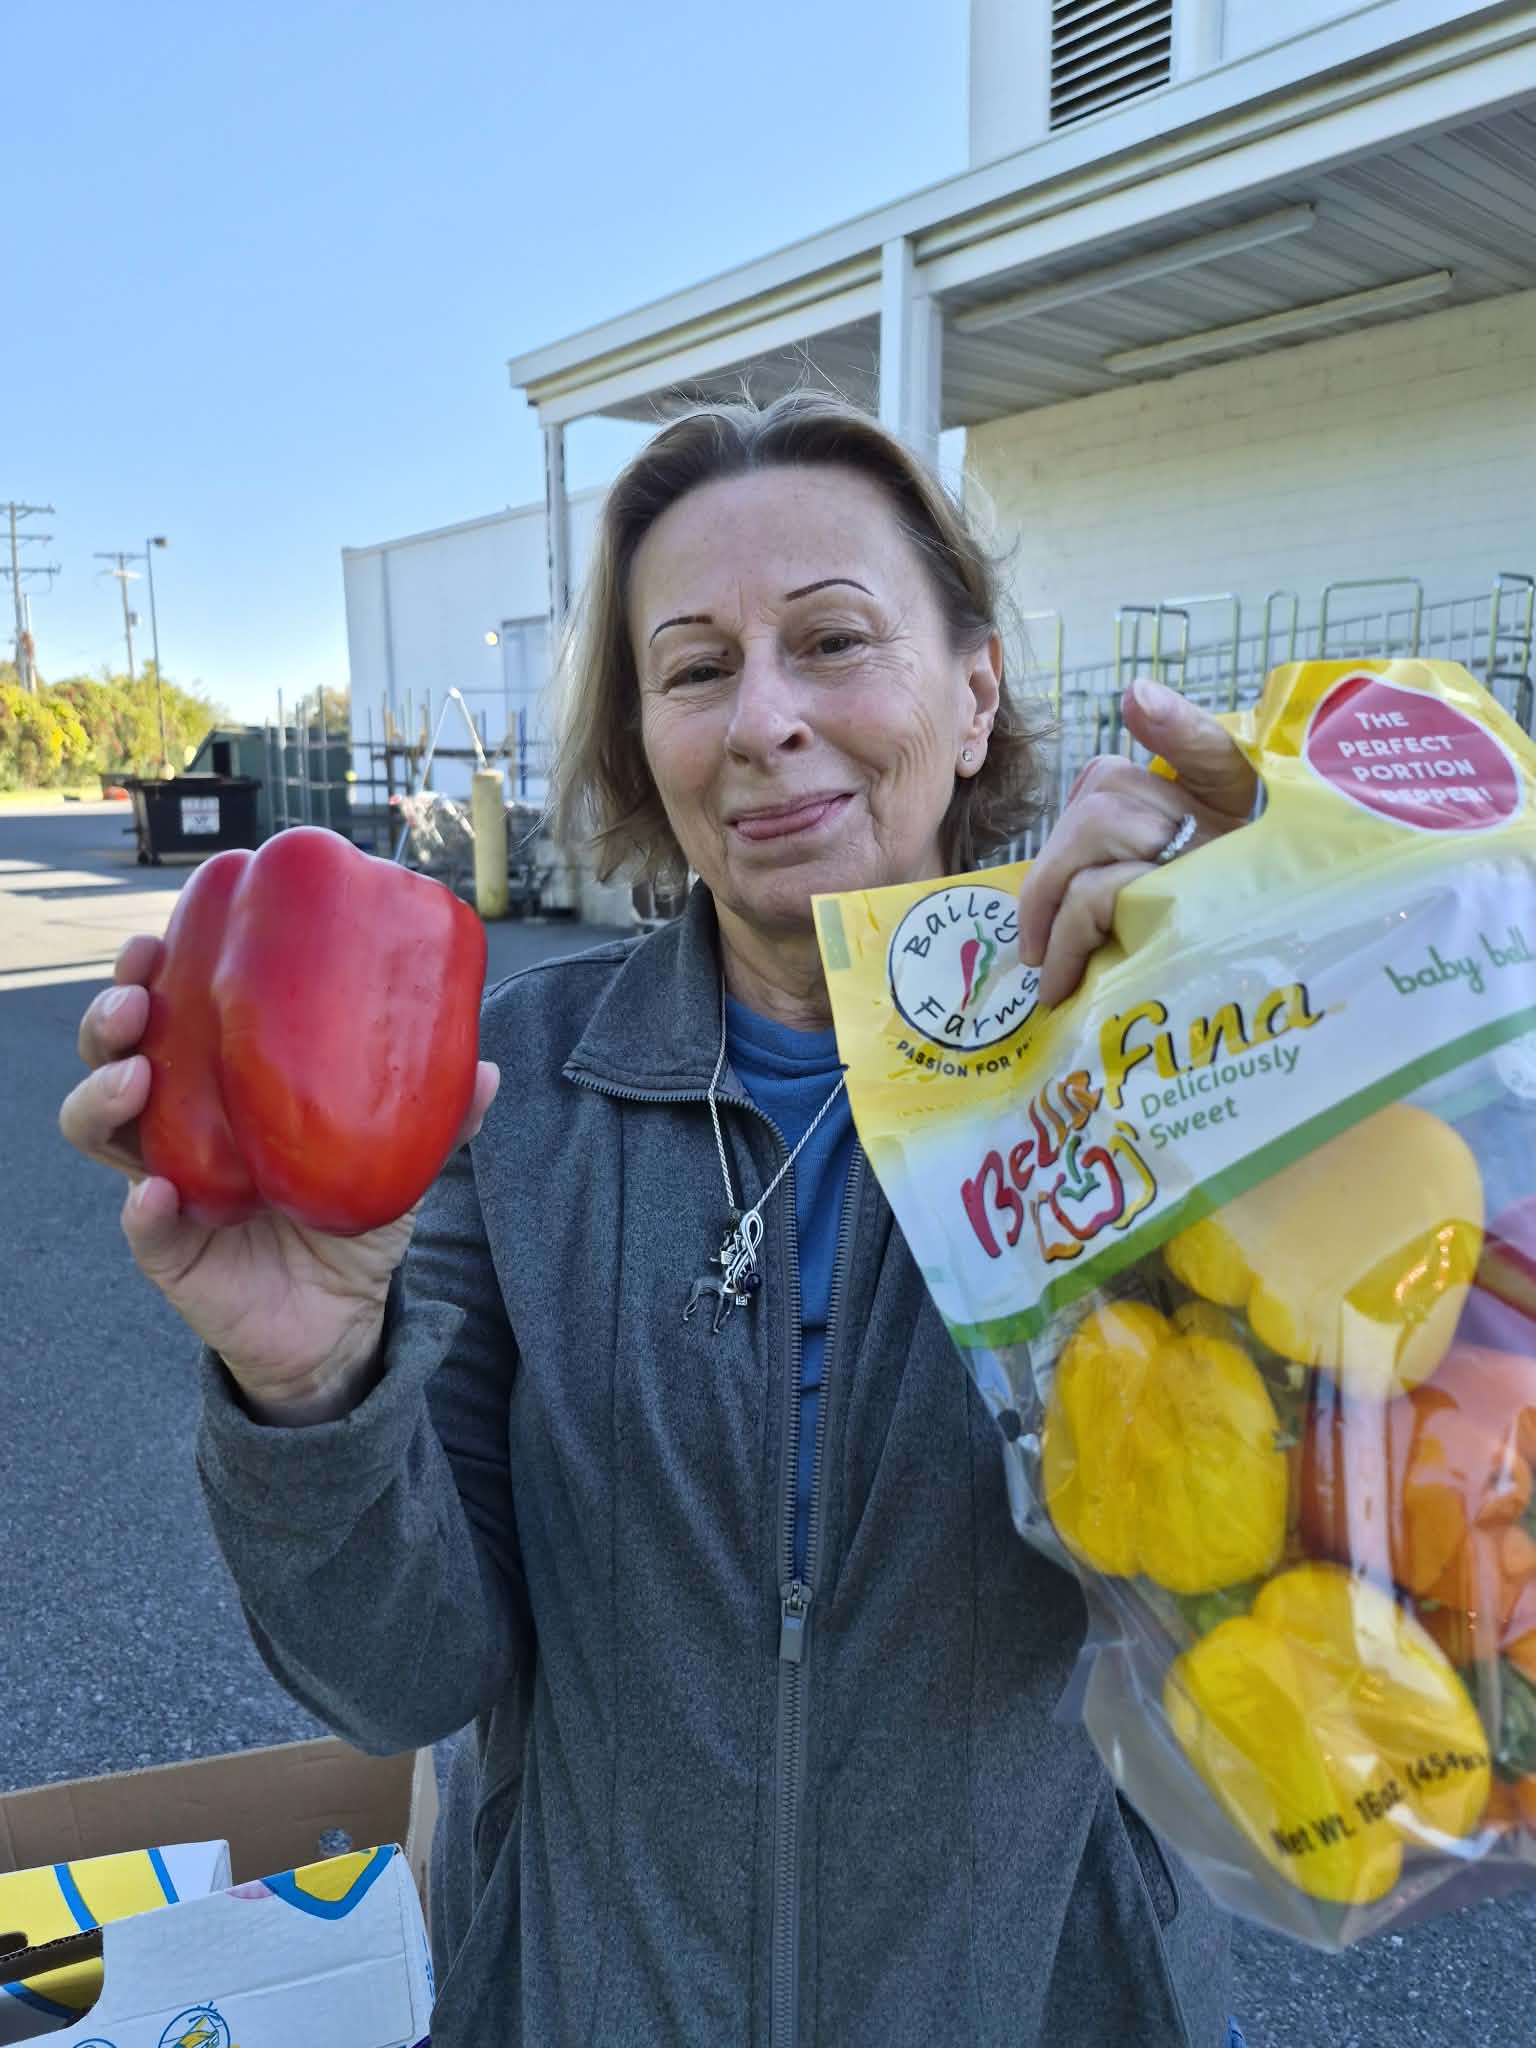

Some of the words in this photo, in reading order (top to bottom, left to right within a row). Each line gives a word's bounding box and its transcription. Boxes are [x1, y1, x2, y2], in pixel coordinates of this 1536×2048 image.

[1353, 710, 1409, 731] THE
[1336, 734, 1454, 759] PERFECT
[1351, 759, 1477, 783] PORTION
[1383, 944, 1485, 995] baby
[914, 970, 1040, 1039] Farms
[896, 1038, 969, 1079] PASSION
[975, 1054, 1013, 1078] FOR
[1139, 1043, 1301, 1120] Deliciously
[1148, 1096, 1240, 1150] Sweet
